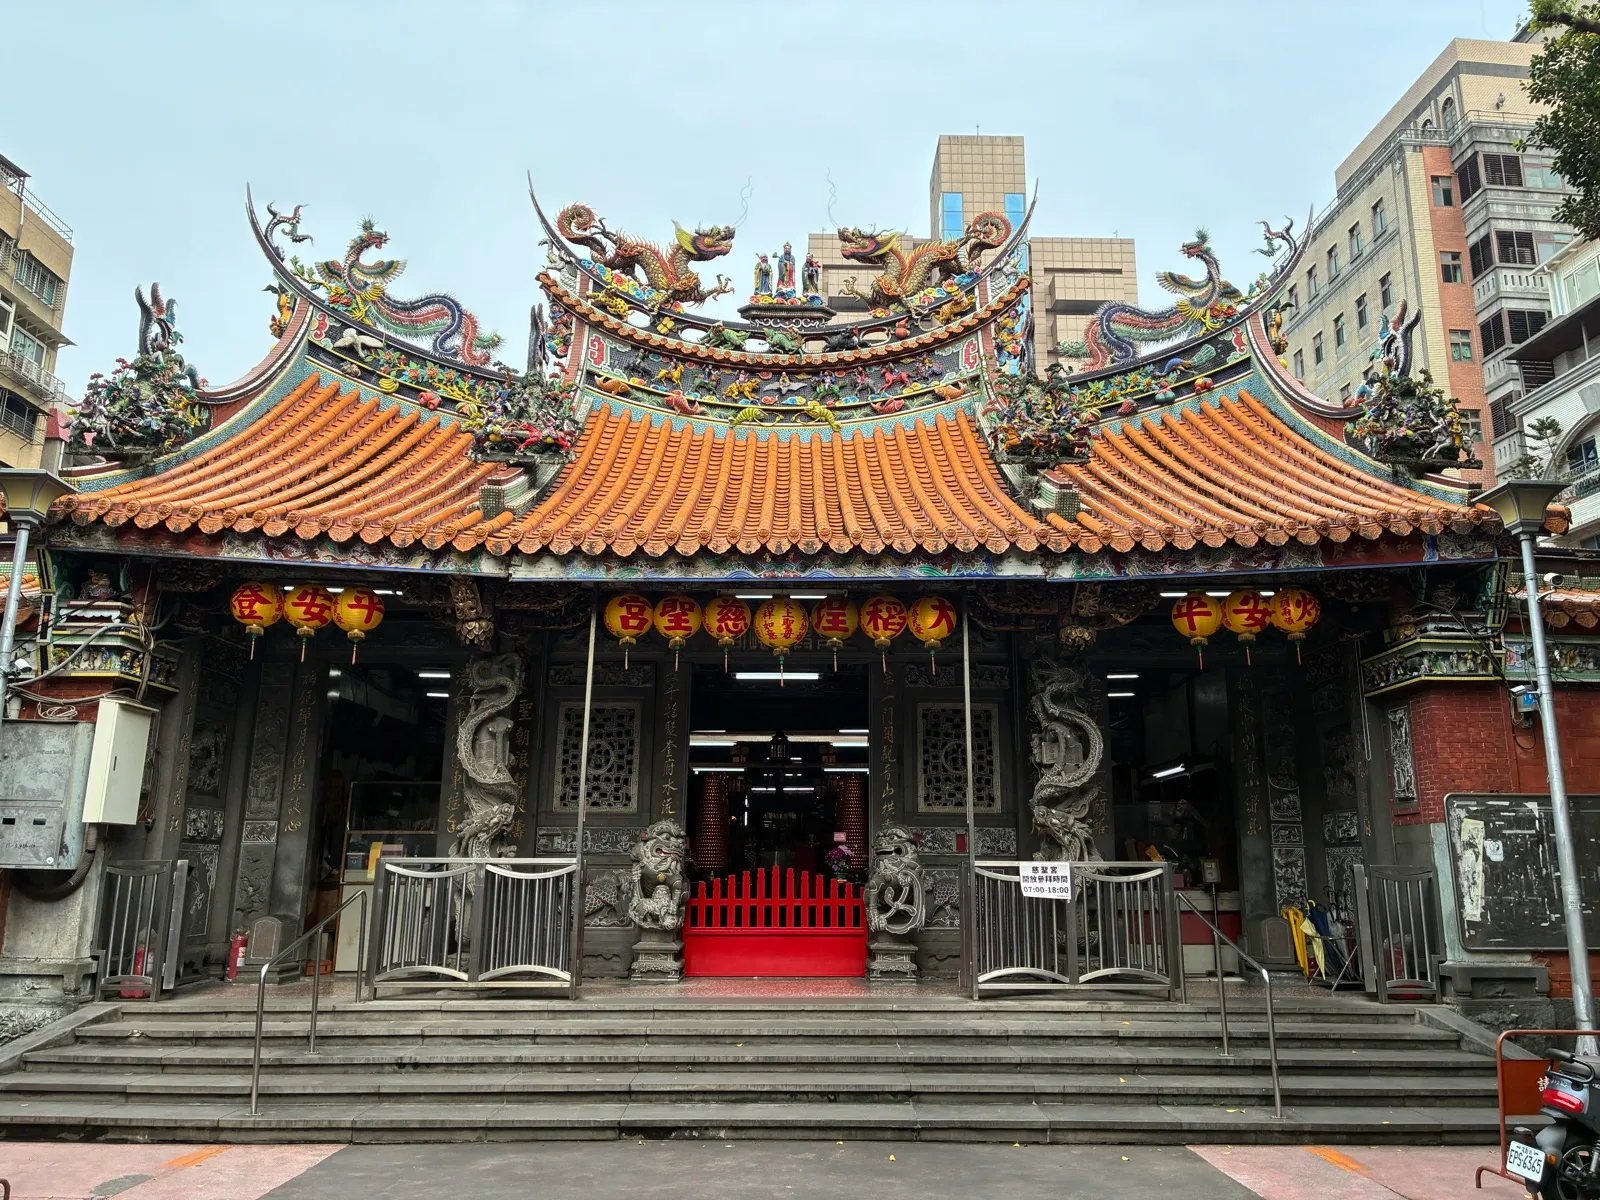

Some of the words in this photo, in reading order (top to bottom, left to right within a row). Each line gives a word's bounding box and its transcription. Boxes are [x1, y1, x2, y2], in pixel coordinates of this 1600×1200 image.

[782, 601, 794, 639] 天上聖母
[1031, 866, 1058, 874] 慈聖宮
[1022, 875, 1068, 884] 開放參拜時間
[1023, 886, 1069, 894] 07:00-18:00
